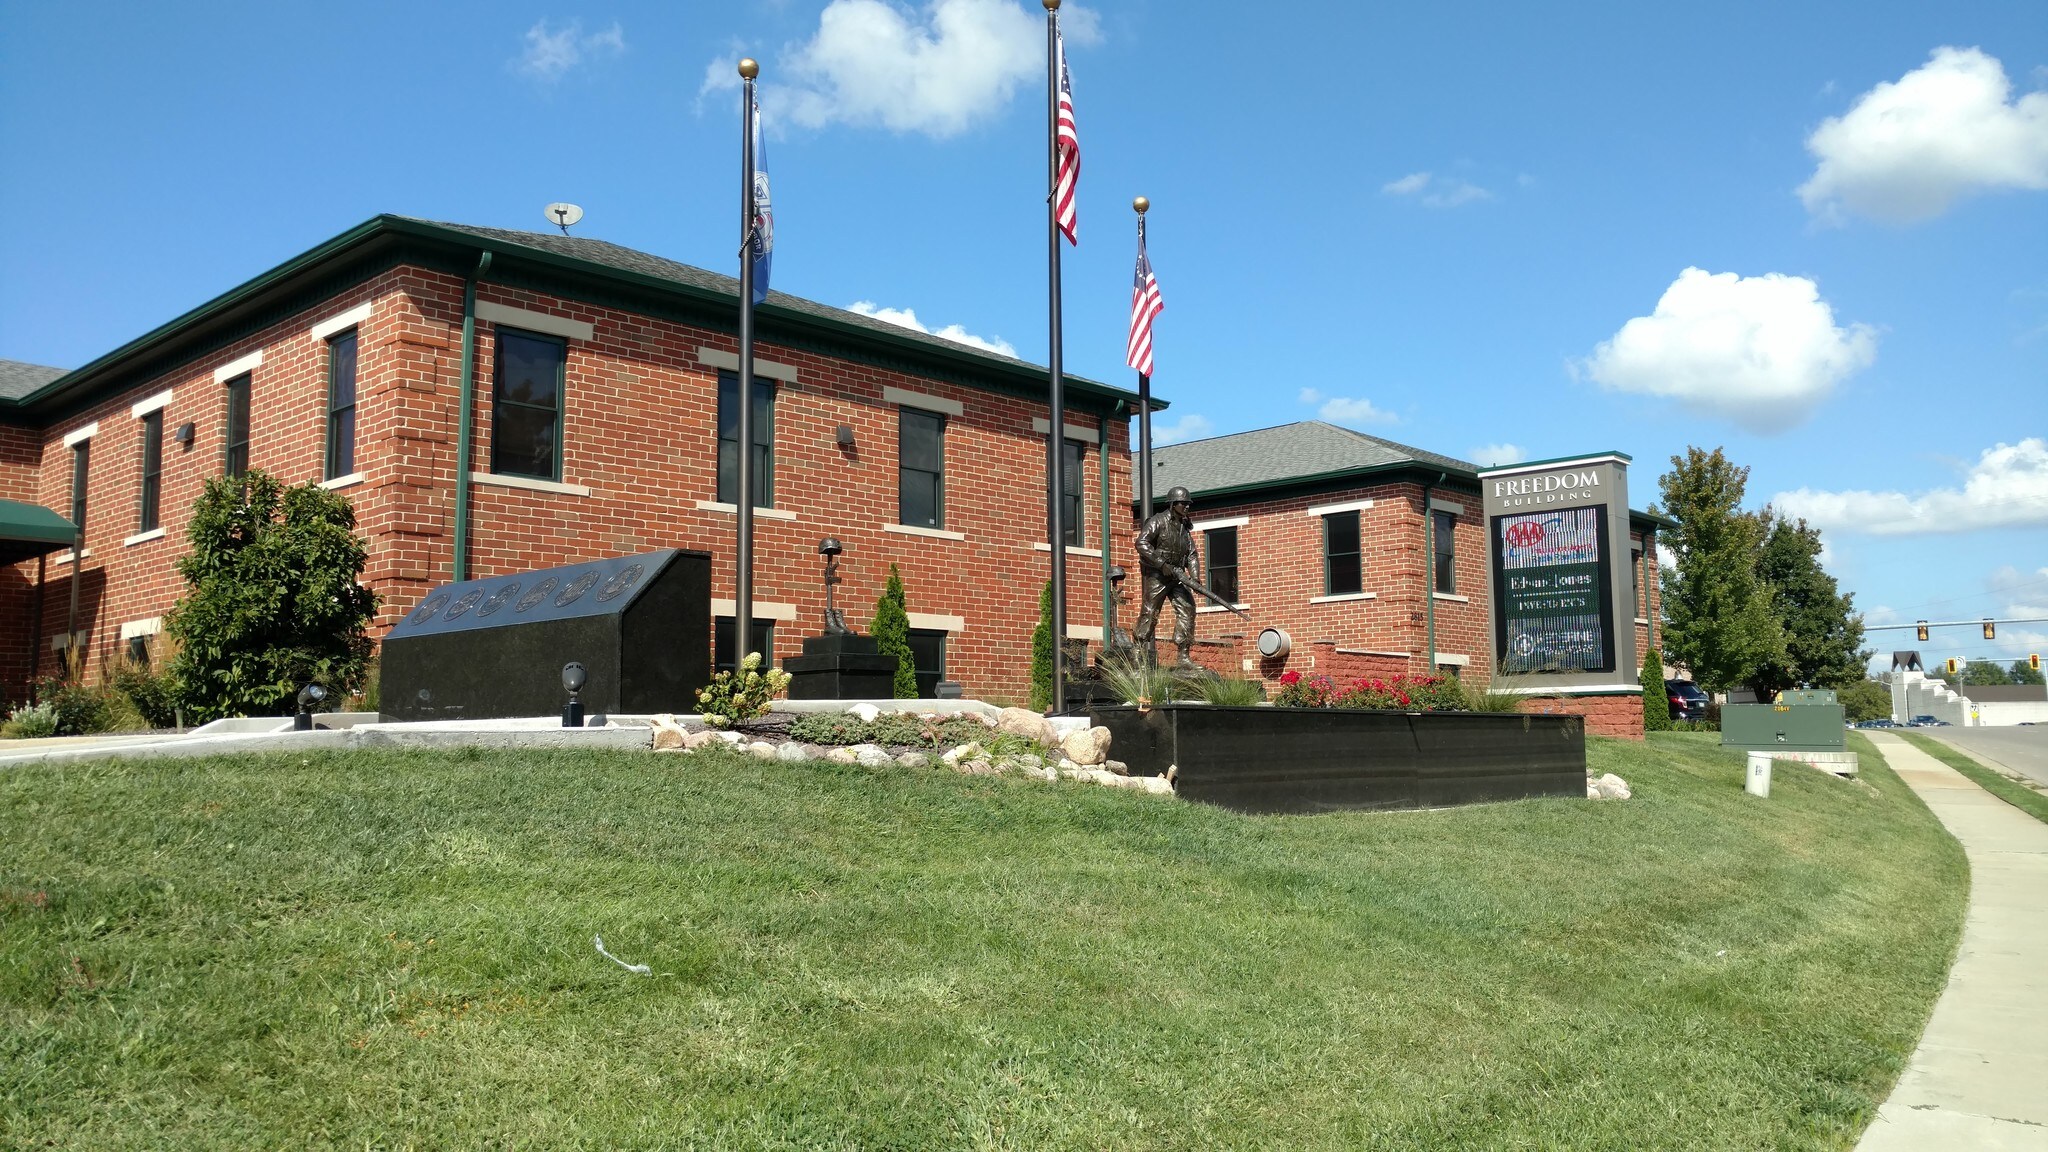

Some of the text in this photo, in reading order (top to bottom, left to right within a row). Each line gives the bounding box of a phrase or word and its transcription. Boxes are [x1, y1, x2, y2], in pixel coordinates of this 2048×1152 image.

[1494, 470, 1600, 498] FREEDOM
[1503, 489, 1592, 508] BUILDING
[1507, 522, 1543, 547] AAA
